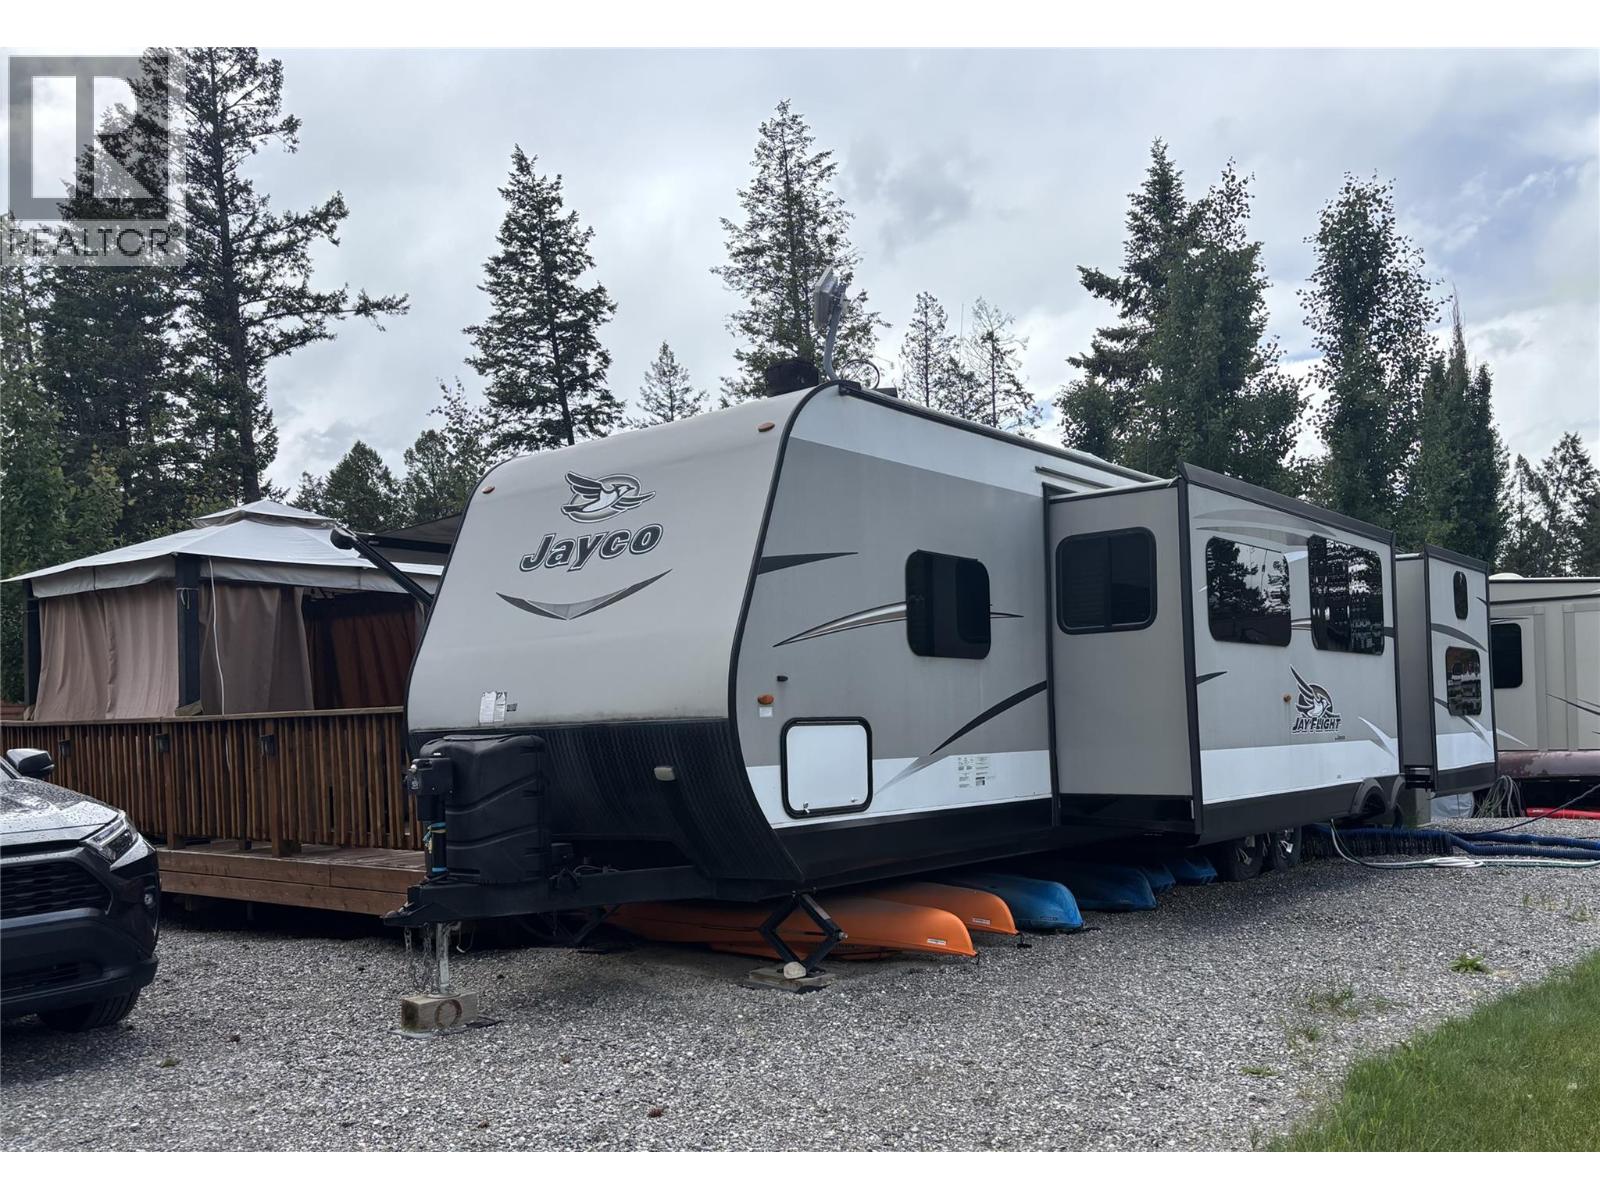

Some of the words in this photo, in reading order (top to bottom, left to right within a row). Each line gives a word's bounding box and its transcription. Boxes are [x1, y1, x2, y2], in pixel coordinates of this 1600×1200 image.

[519, 523, 664, 572] Jayco
[1292, 717, 1310, 731] JAY
[1310, 716, 1342, 731] FLIGHT
